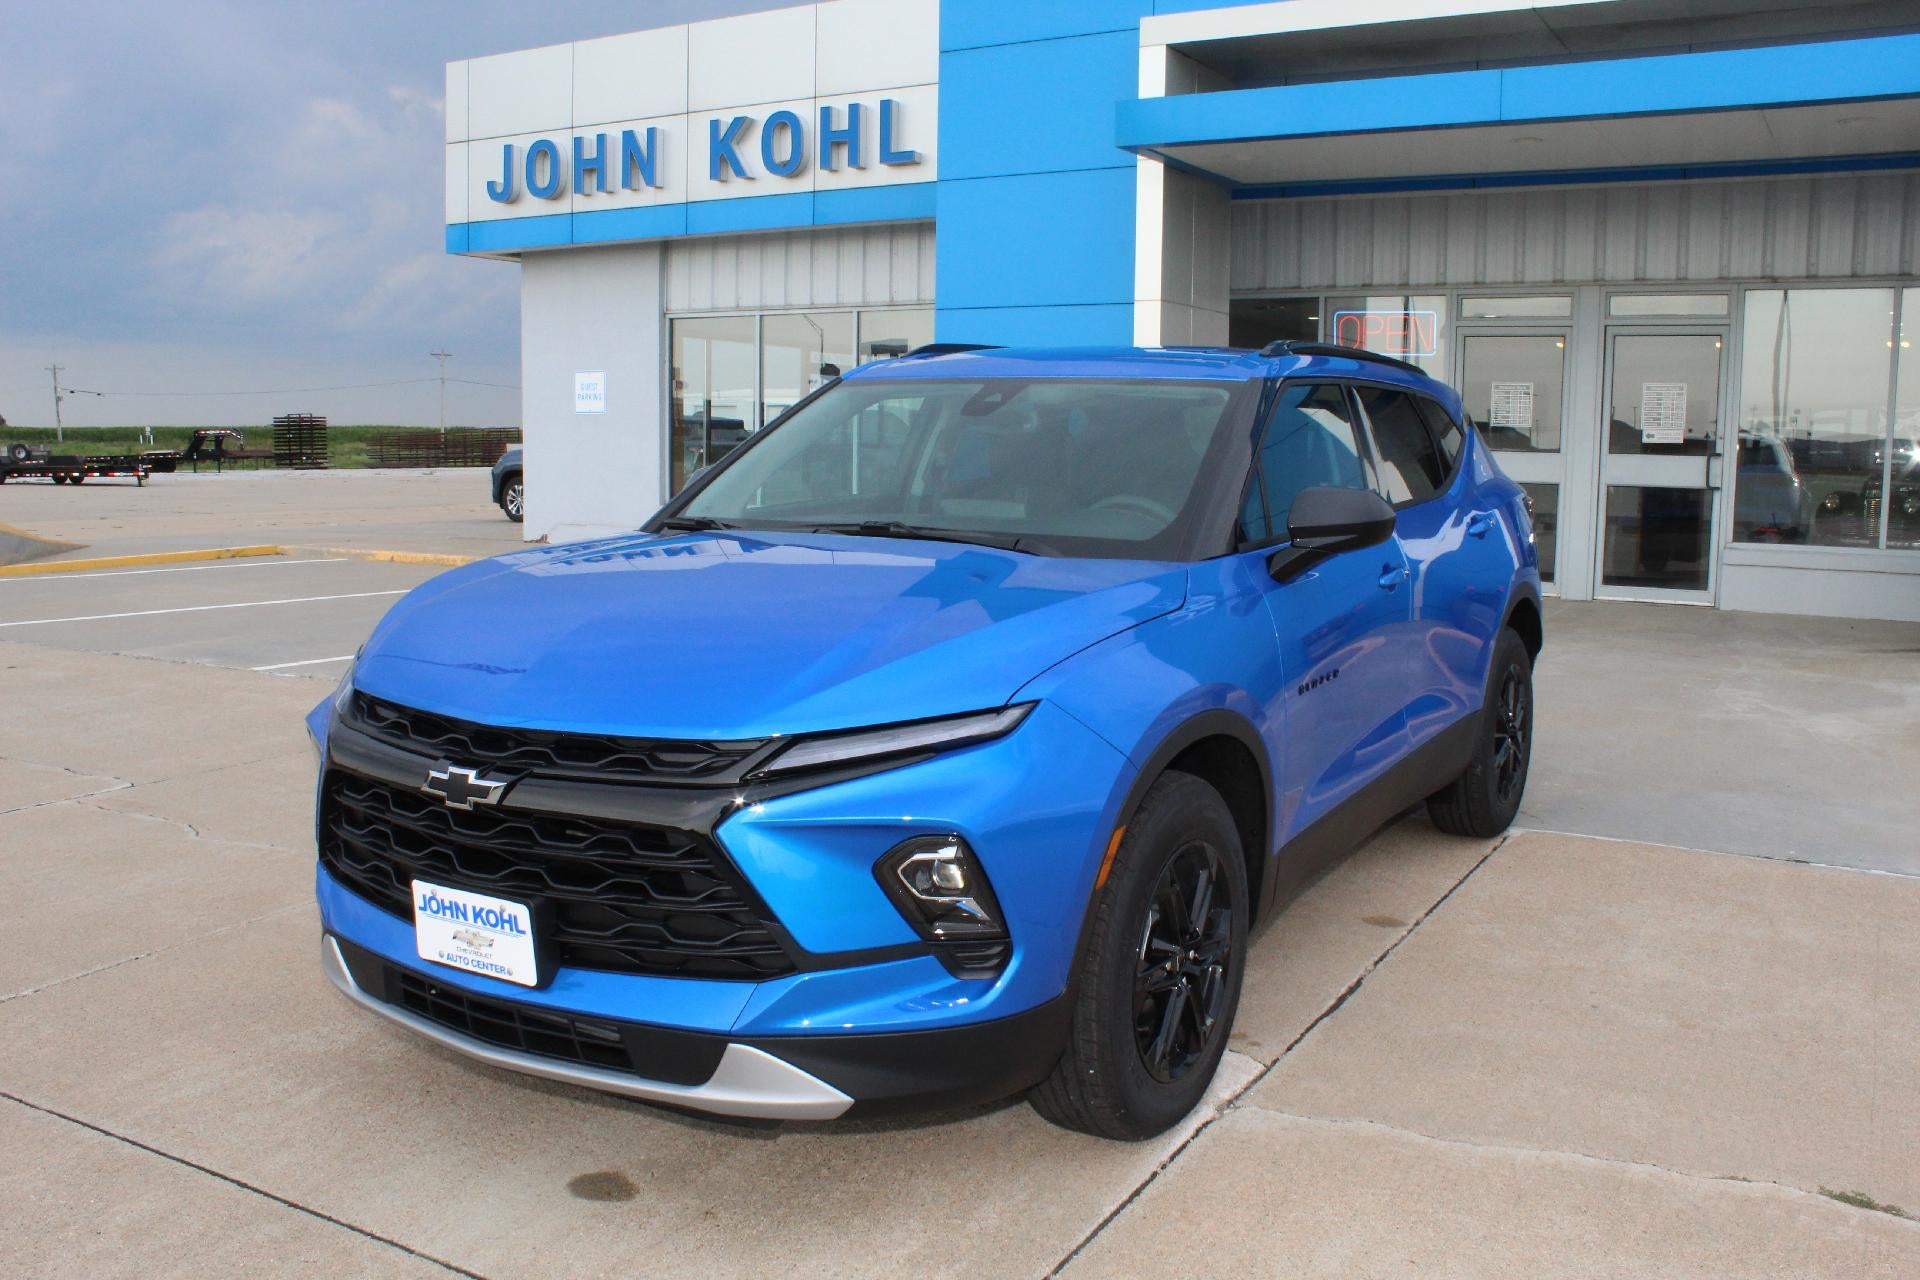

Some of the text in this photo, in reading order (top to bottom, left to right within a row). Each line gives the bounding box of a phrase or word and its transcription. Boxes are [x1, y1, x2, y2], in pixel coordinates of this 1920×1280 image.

[486, 98, 922, 204] JOHN KOHL
[1338, 314, 1434, 352] OPEN
[418, 893, 527, 935] JOHN KOHL
[446, 952, 507, 975] AUTO CENTER
[456, 946, 492, 960] CHEVROLET
